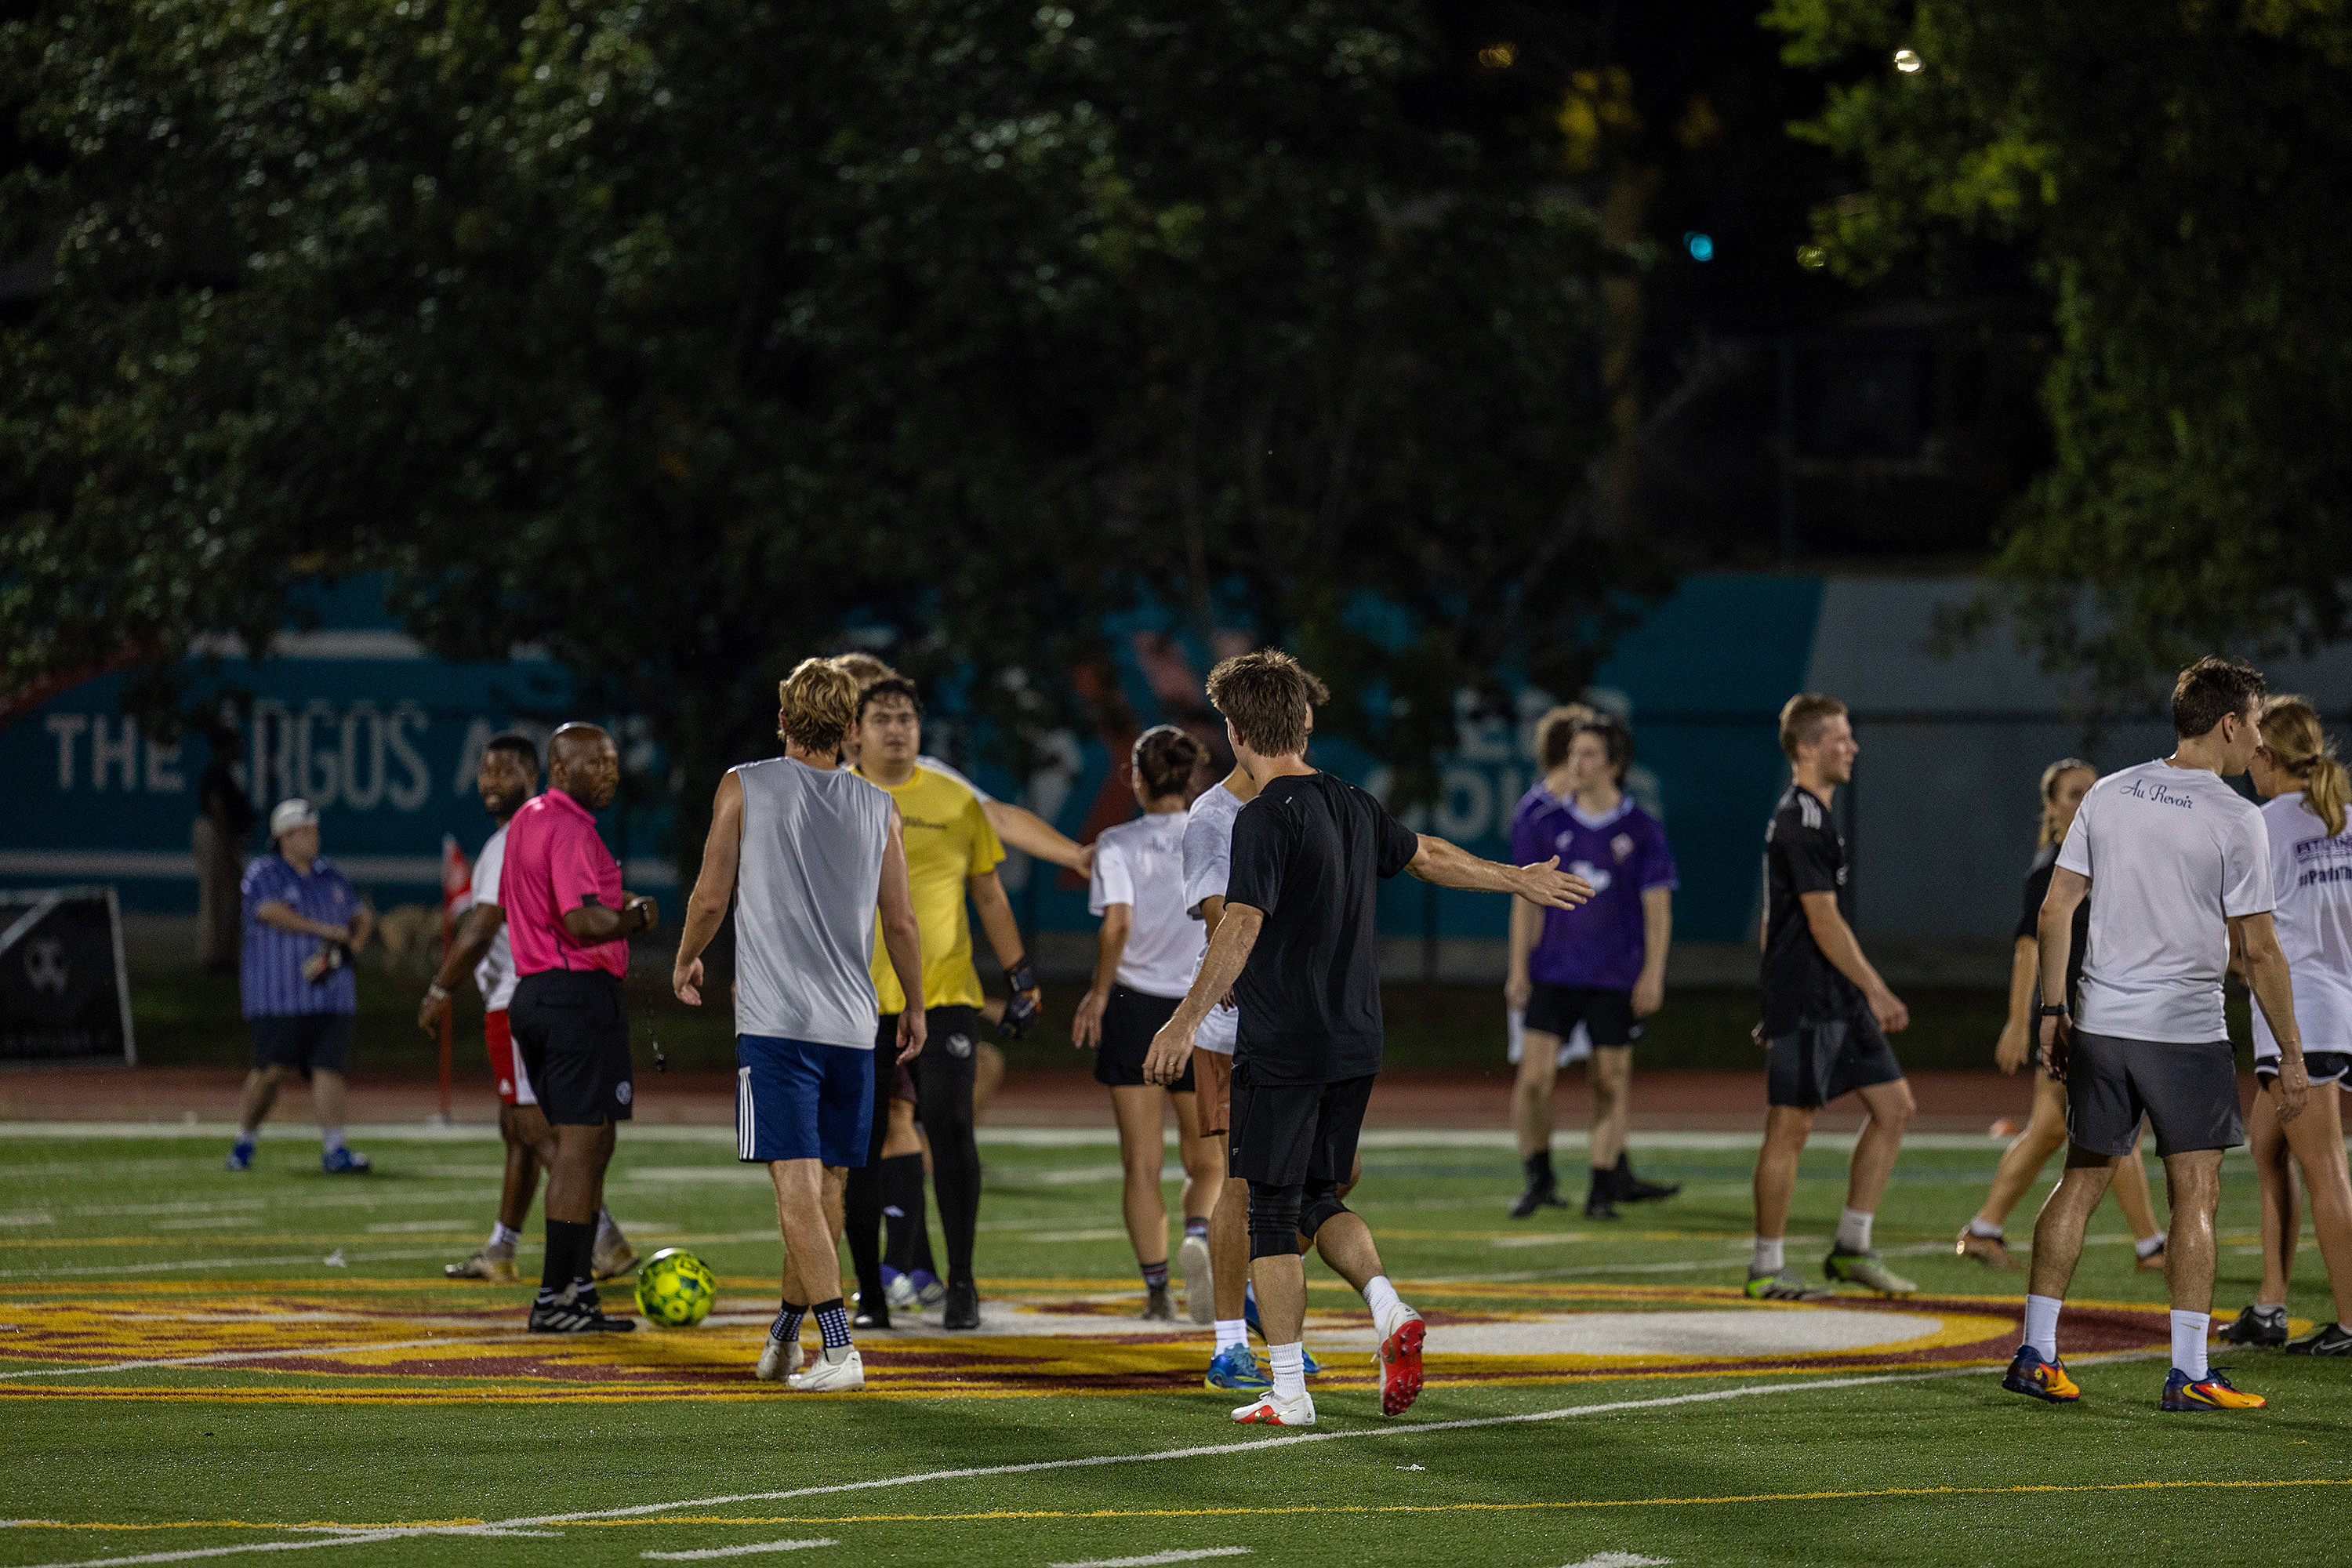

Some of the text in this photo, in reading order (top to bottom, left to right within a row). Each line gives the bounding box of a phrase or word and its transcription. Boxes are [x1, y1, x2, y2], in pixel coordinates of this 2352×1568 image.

[45, 713, 186, 793] THE
[2119, 779, 2193, 809] Au Revoir
